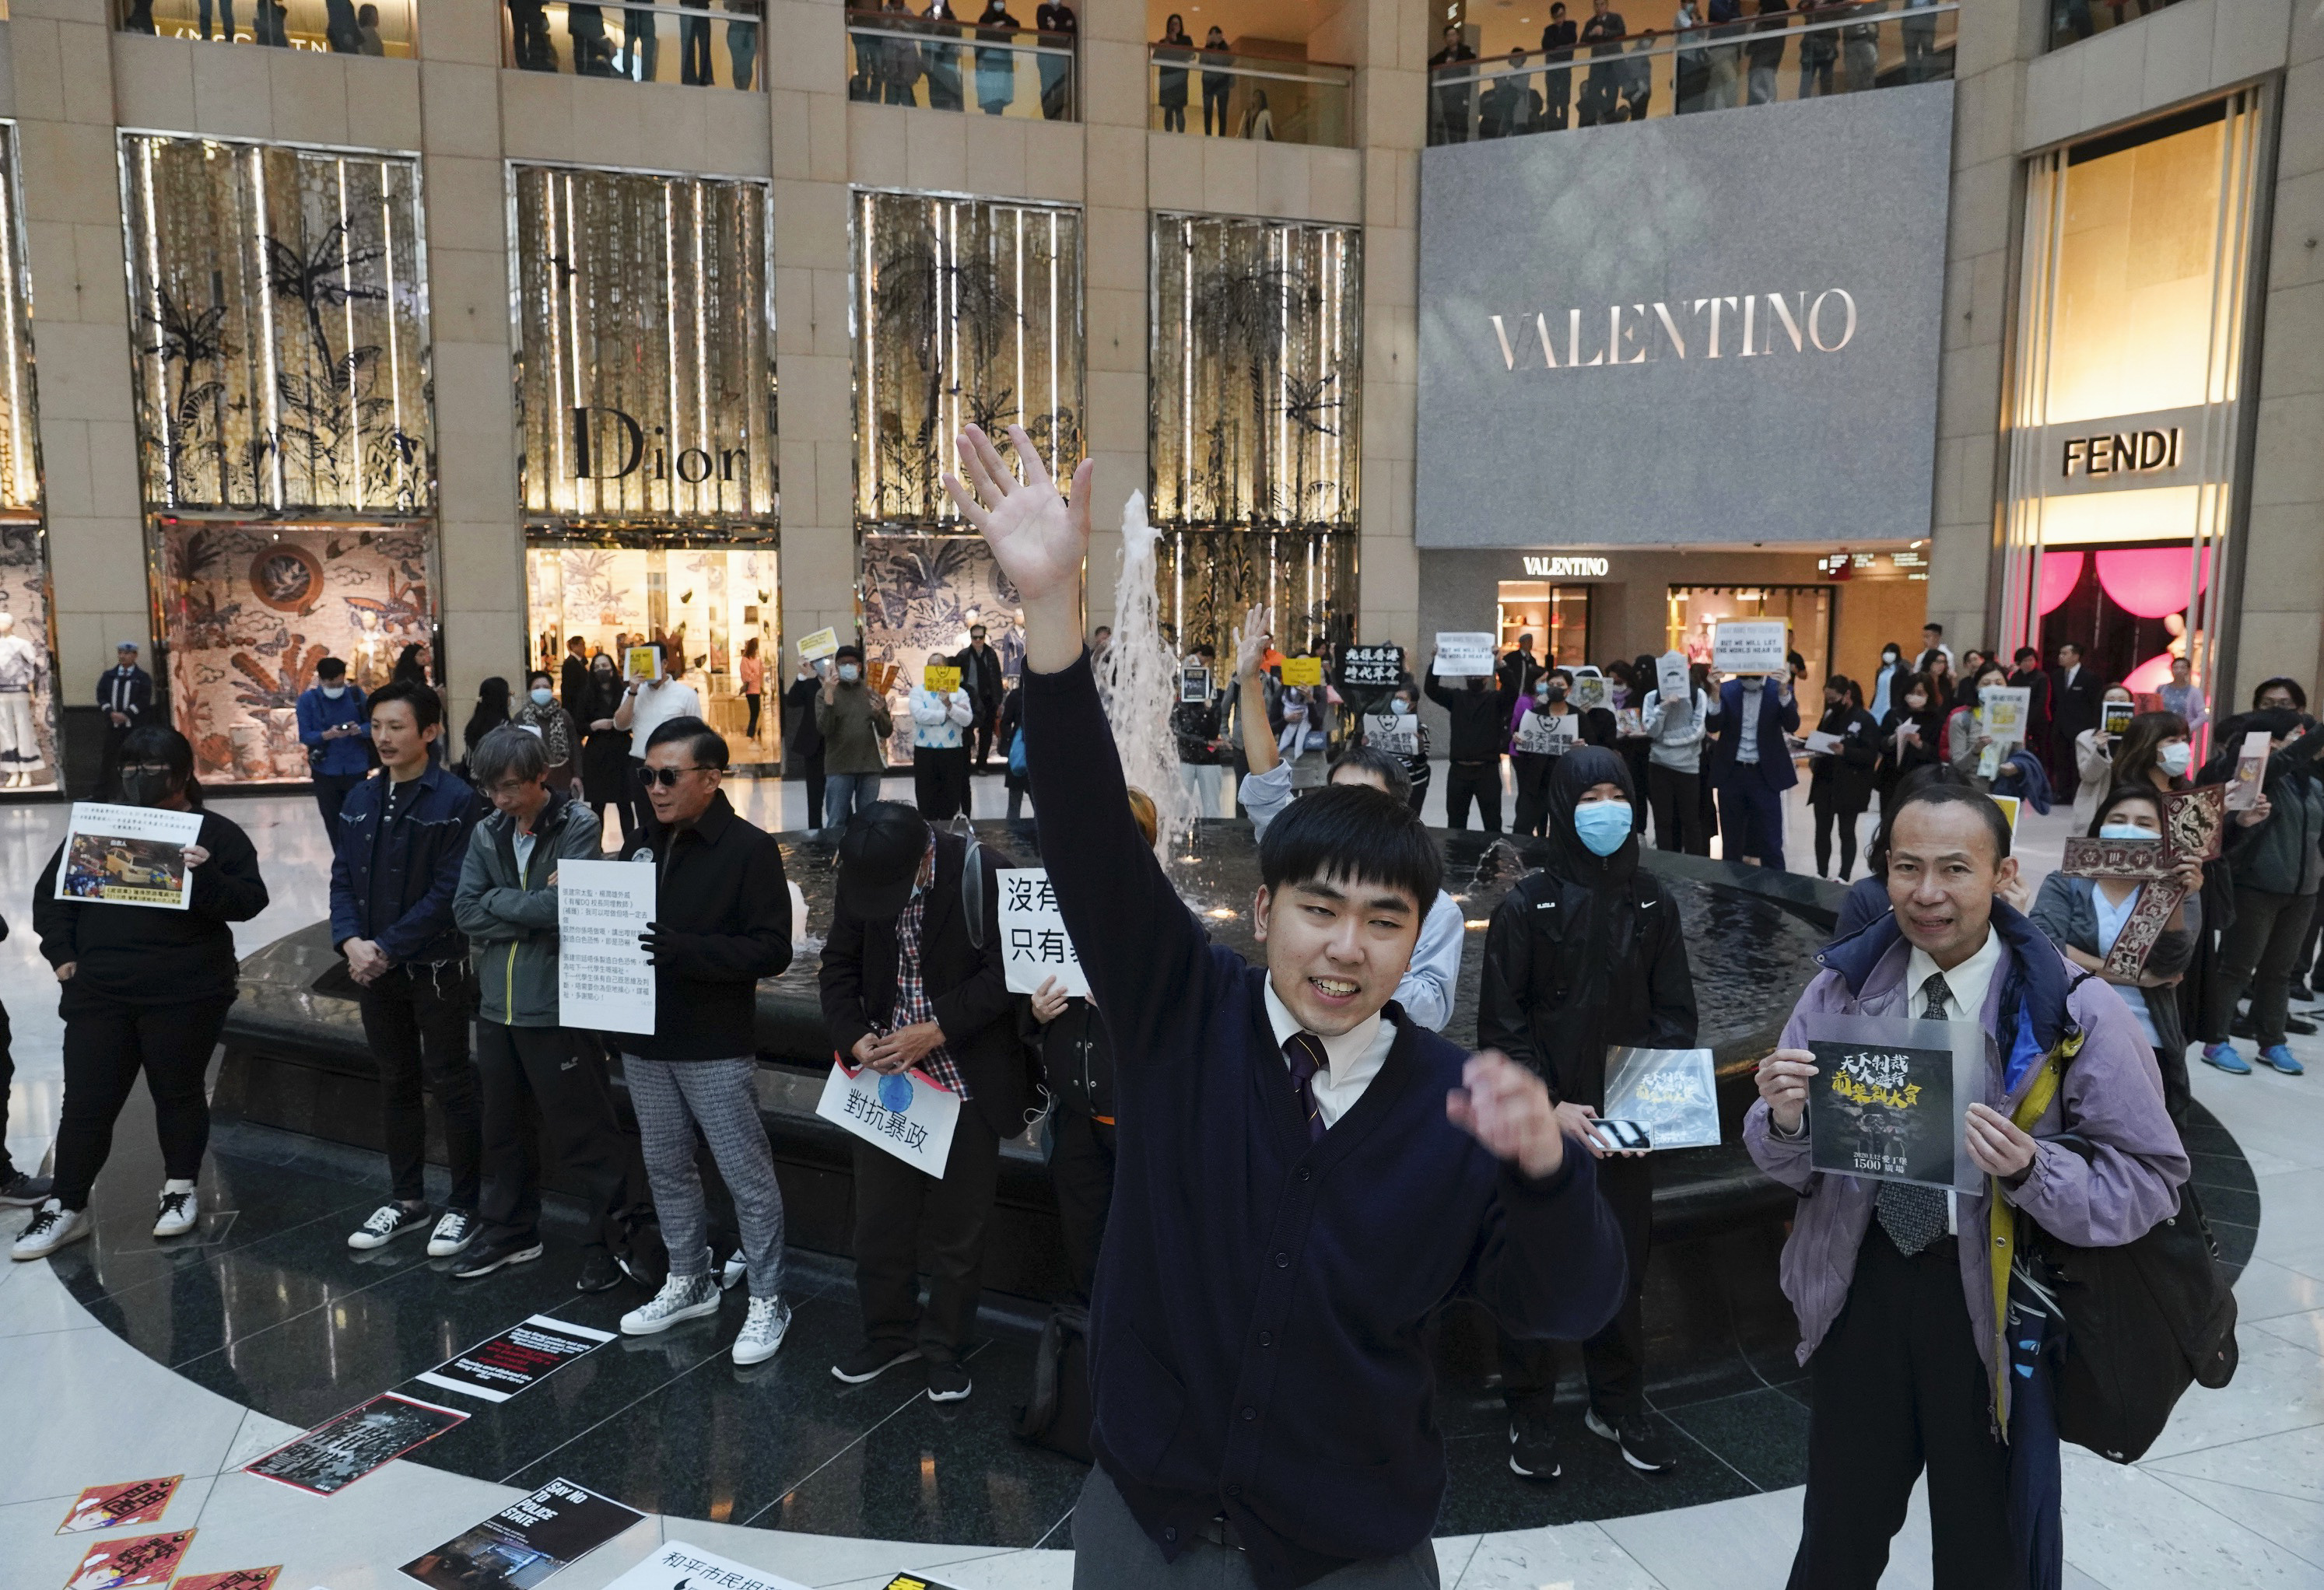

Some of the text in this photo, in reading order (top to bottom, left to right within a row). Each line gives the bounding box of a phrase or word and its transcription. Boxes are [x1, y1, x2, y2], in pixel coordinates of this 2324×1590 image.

[1488, 288, 1857, 371] VALENTINO
[564, 407, 745, 482] Dior
[2062, 427, 2183, 477] FENDI
[1523, 557, 1609, 576] VALENTINO
[1011, 929, 1079, 963] 只有
[1840, 1052, 1909, 1073] 天下制裁
[843, 1088, 928, 1153] 對抗暴政
[1854, 1157, 1881, 1171] 1500
[531, 1490, 552, 1503] TO
[545, 1481, 588, 1504] SAY NO
[500, 1507, 539, 1527] STATE
[515, 1498, 559, 1521] POLICE
[662, 1551, 781, 1590] 和平市民坦
